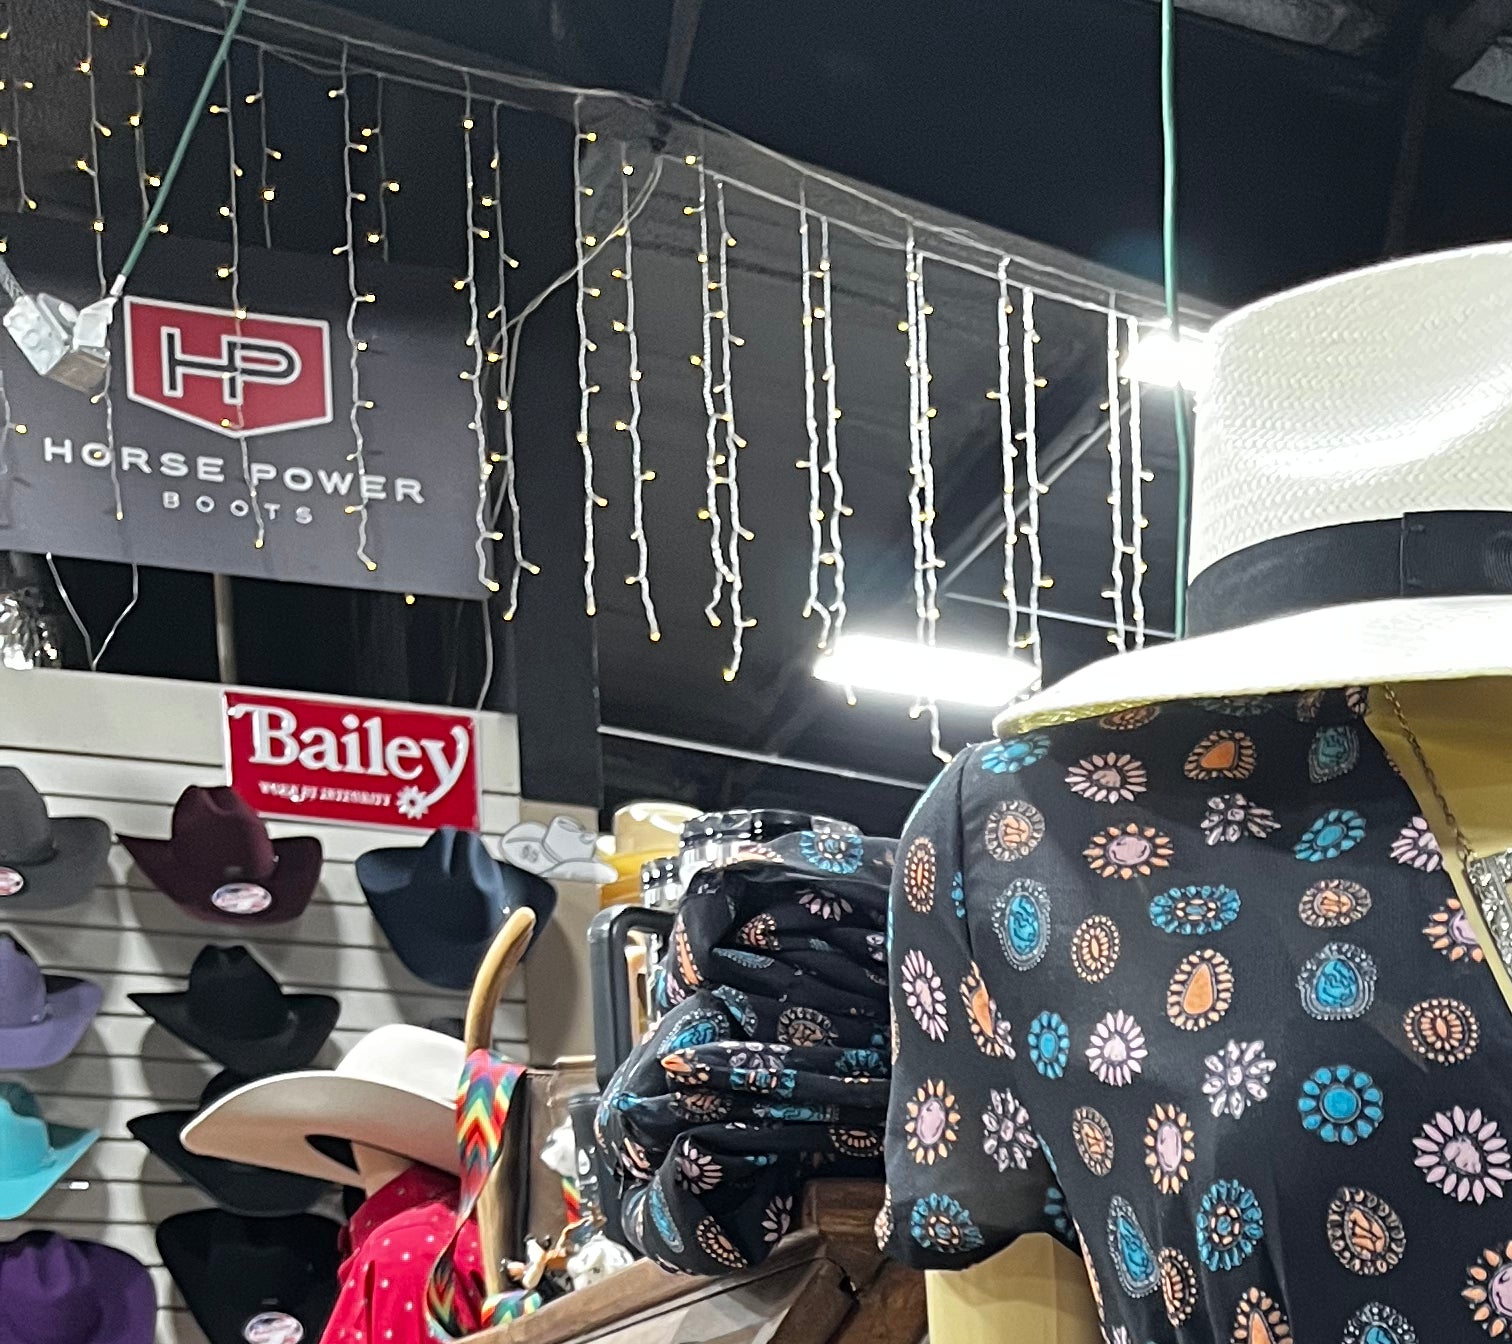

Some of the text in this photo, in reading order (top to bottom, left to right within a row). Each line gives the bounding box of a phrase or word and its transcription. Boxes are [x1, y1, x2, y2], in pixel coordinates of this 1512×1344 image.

[160, 326, 302, 405] HP
[43, 436, 425, 504] HORSE POWER
[162, 491, 314, 525] BOOTS
[228, 703, 470, 808] Bailey
